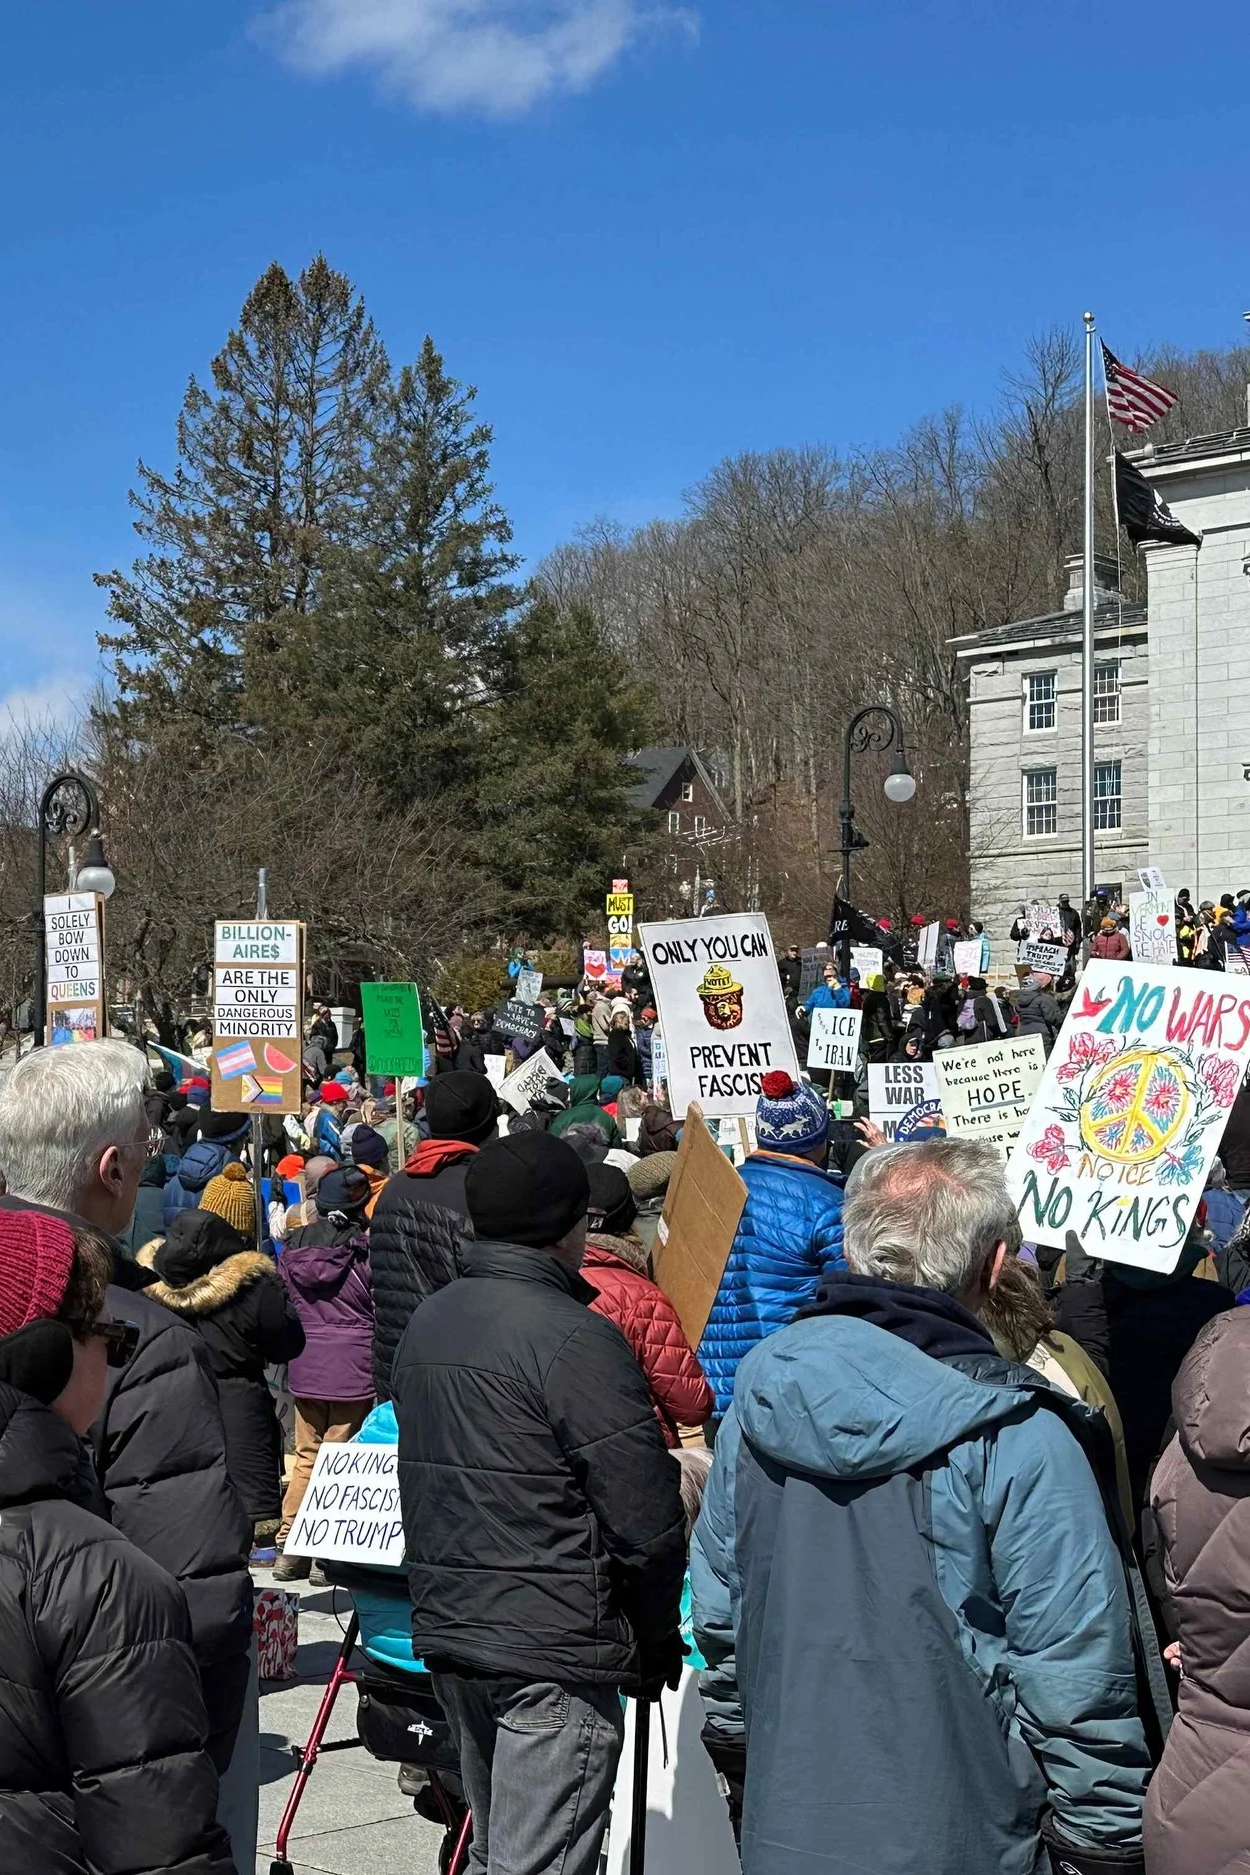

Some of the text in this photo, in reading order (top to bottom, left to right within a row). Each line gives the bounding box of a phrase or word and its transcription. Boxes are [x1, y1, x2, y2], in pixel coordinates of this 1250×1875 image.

[608, 896, 632, 912] MUST
[51, 913, 90, 930] SOLELY
[608, 914, 632, 934] GO!
[58, 931, 84, 945] BOW
[222, 926, 291, 940] BILLION-
[55, 947, 90, 963] DOWN
[233, 943, 280, 960] AIRE$
[653, 933, 768, 965] ONLY YOU CAN
[65, 966, 78, 979] TO
[222, 970, 290, 985] ARE THE
[51, 982, 96, 1000] QUEENS
[235, 989, 278, 1003] ONLY
[218, 1008, 293, 1018] DANGEROUS
[507, 1001, 536, 1017] VOTE TO
[1095, 976, 1250, 1051] NO WARS
[219, 1022, 293, 1036] MINORITY
[495, 1019, 537, 1039] DEMOCRACY
[831, 1016, 856, 1037] ICE
[690, 1043, 771, 1068] PREVENT
[942, 1048, 1036, 1071] We're not here
[885, 1065, 924, 1083] LESS
[946, 1061, 1039, 1086] because there is
[698, 1073, 766, 1097] FASCIS
[885, 1087, 925, 1105] WAR
[953, 1114, 991, 1127] There
[998, 1110, 1008, 1120] is
[1077, 1153, 1156, 1186] NO ICE
[1018, 1170, 1073, 1228] NO
[318, 1451, 350, 1476] NO
[306, 1483, 339, 1511] NO
[294, 1518, 403, 1550] NO TRUMP
